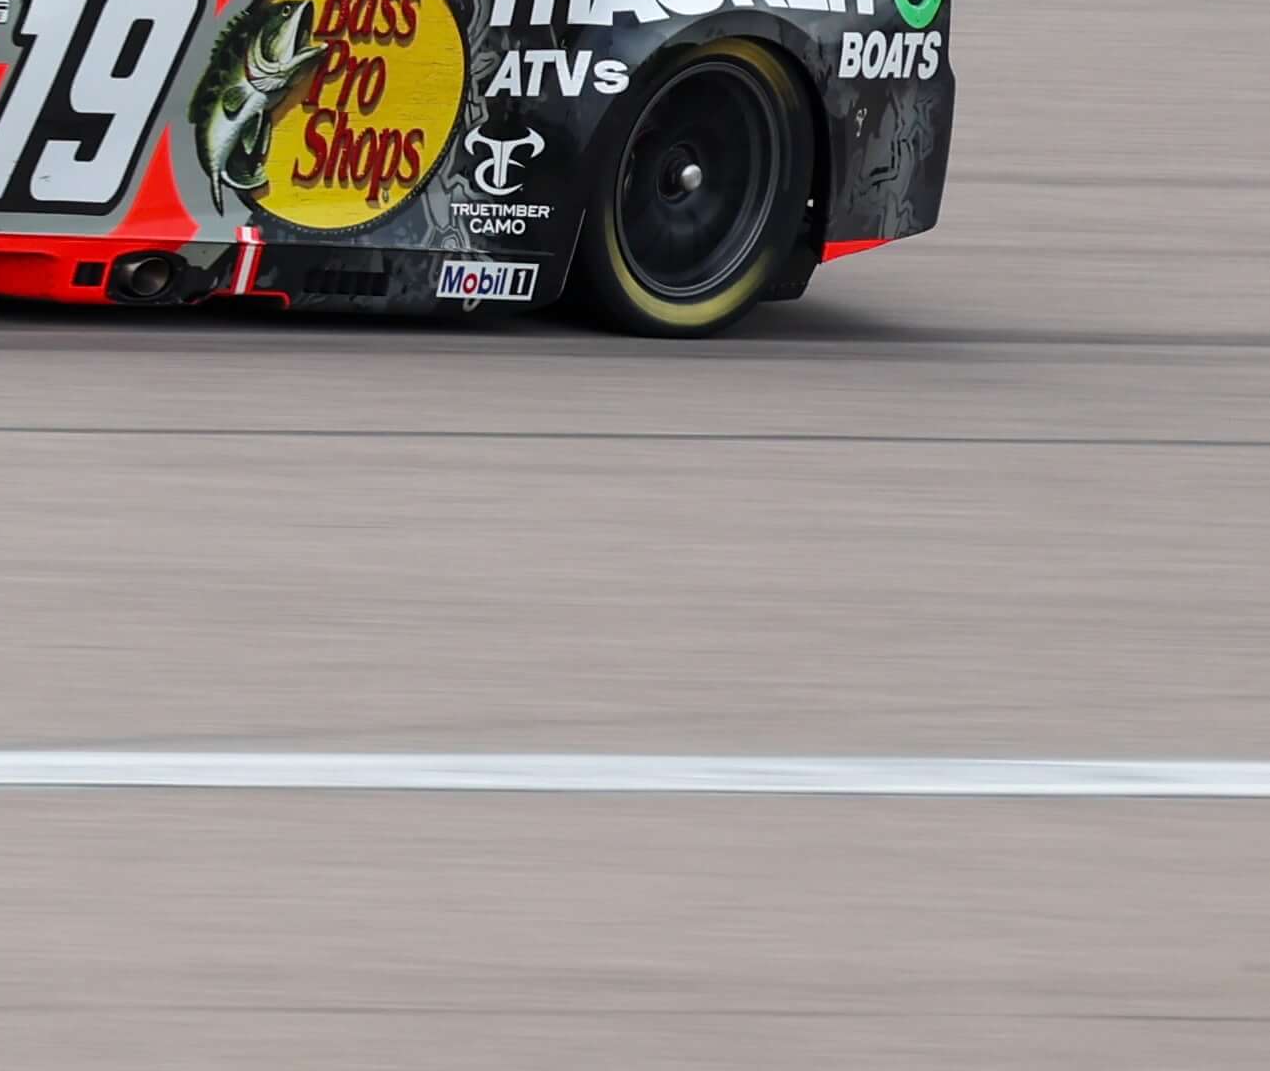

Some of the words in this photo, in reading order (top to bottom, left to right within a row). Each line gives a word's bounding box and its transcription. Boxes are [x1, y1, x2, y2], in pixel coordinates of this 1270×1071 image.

[302, 39, 387, 116] Pro
[484, 49, 630, 97] ATVs
[838, 30, 943, 80] BOATS
[291, 108, 425, 209] Shops
[450, 203, 550, 218] TRUETIMBER
[469, 218, 526, 235] CAMO
[440, 265, 508, 296] Mobil
